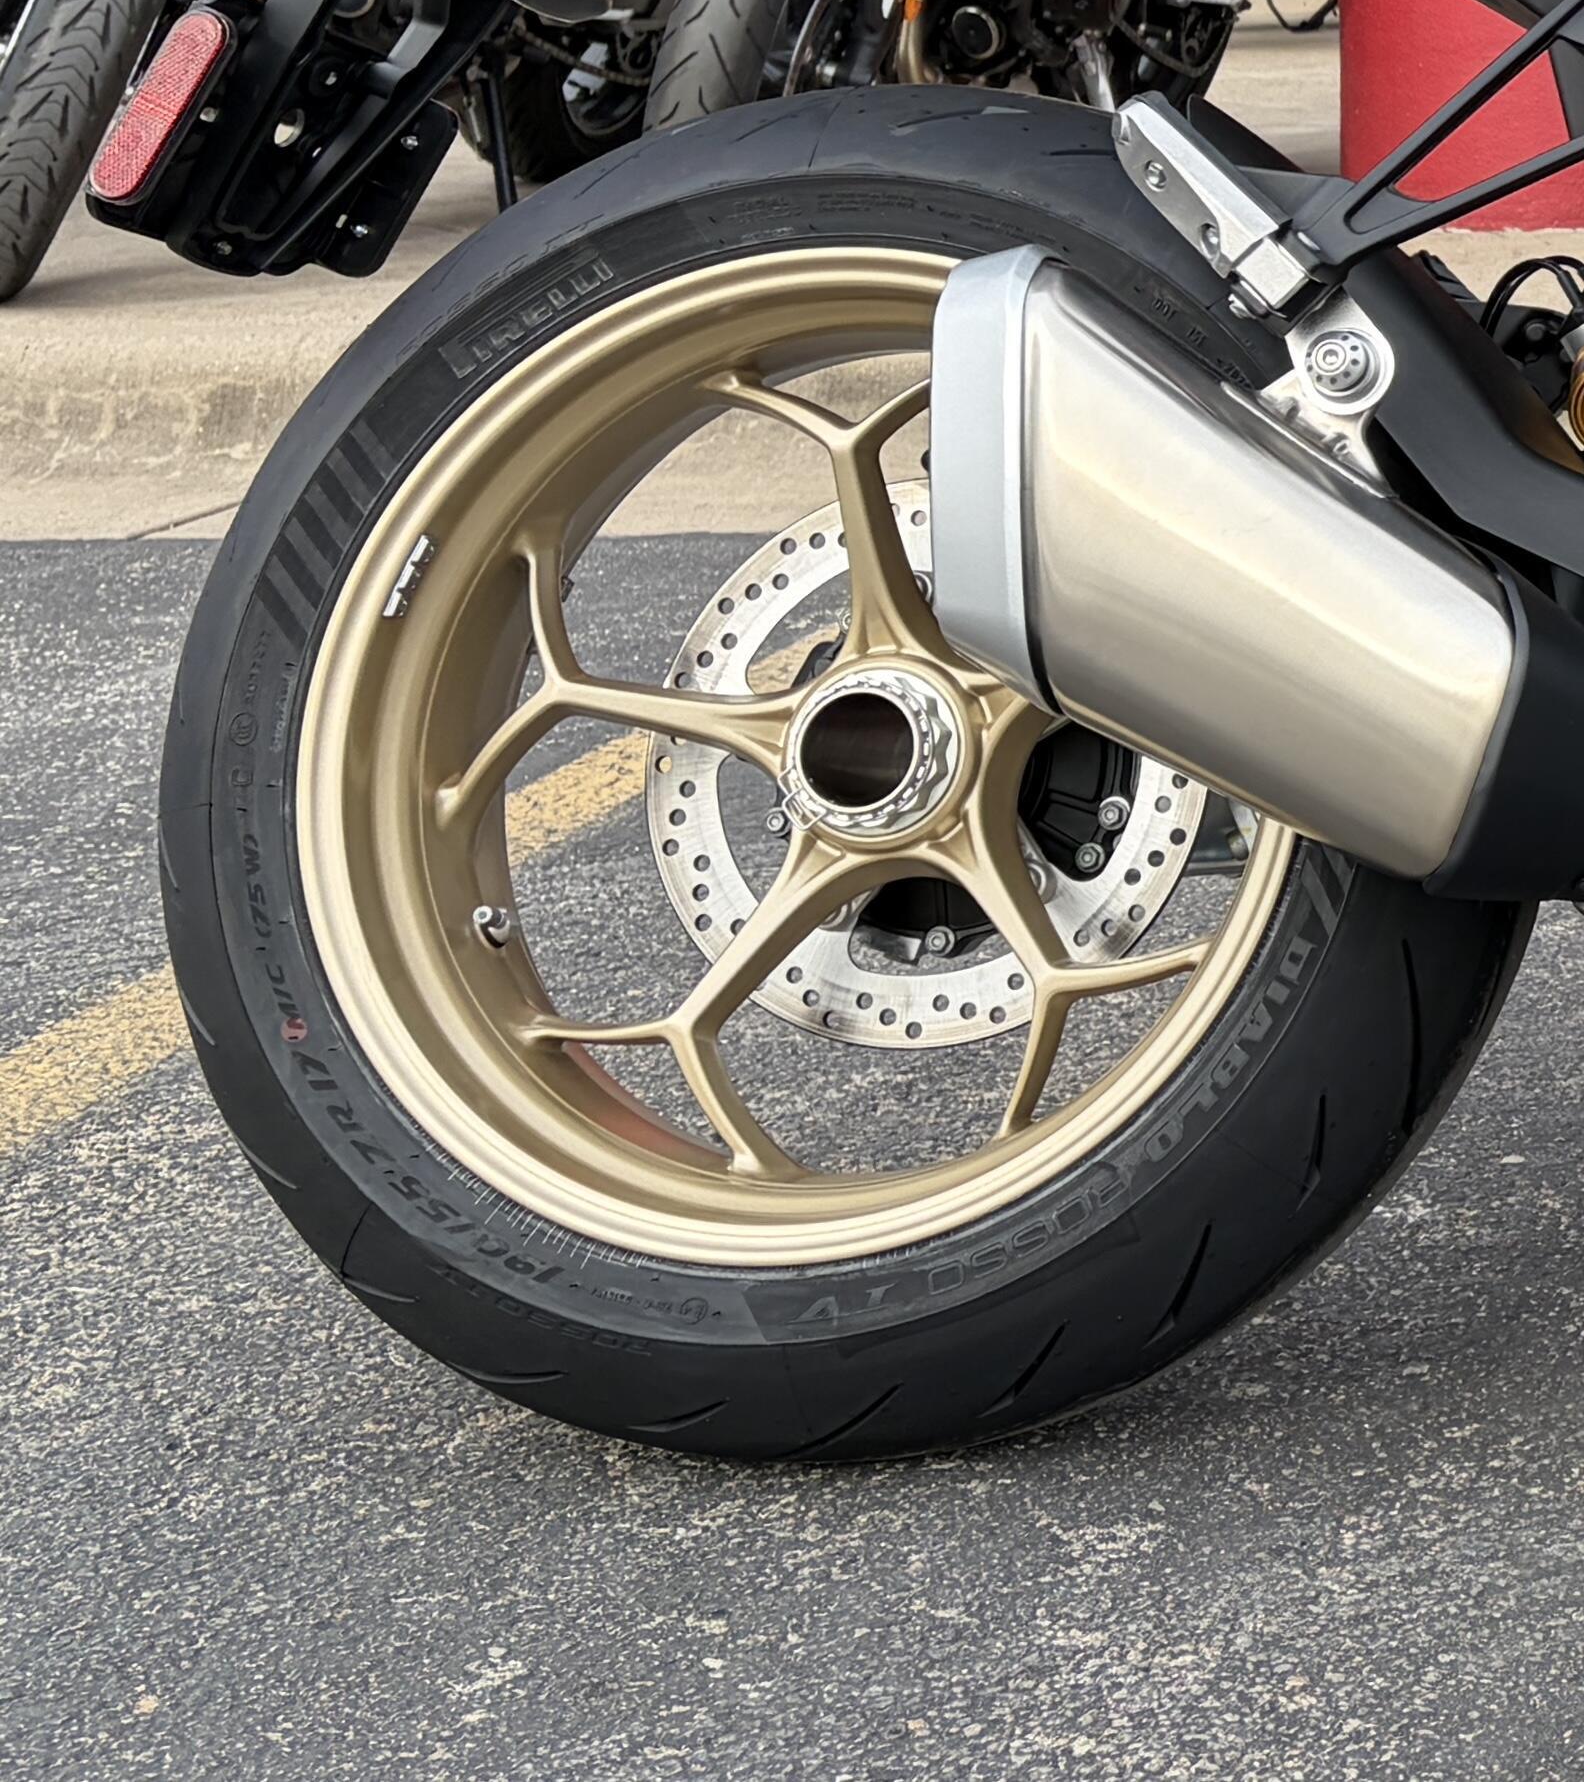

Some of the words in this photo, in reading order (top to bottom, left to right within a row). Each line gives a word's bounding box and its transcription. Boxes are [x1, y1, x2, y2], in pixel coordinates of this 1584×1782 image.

[438, 246, 614, 379] PIRELLI
[1140, 934, 1317, 1166] DIABLO
[925, 1166, 1133, 1295] ROSSO
